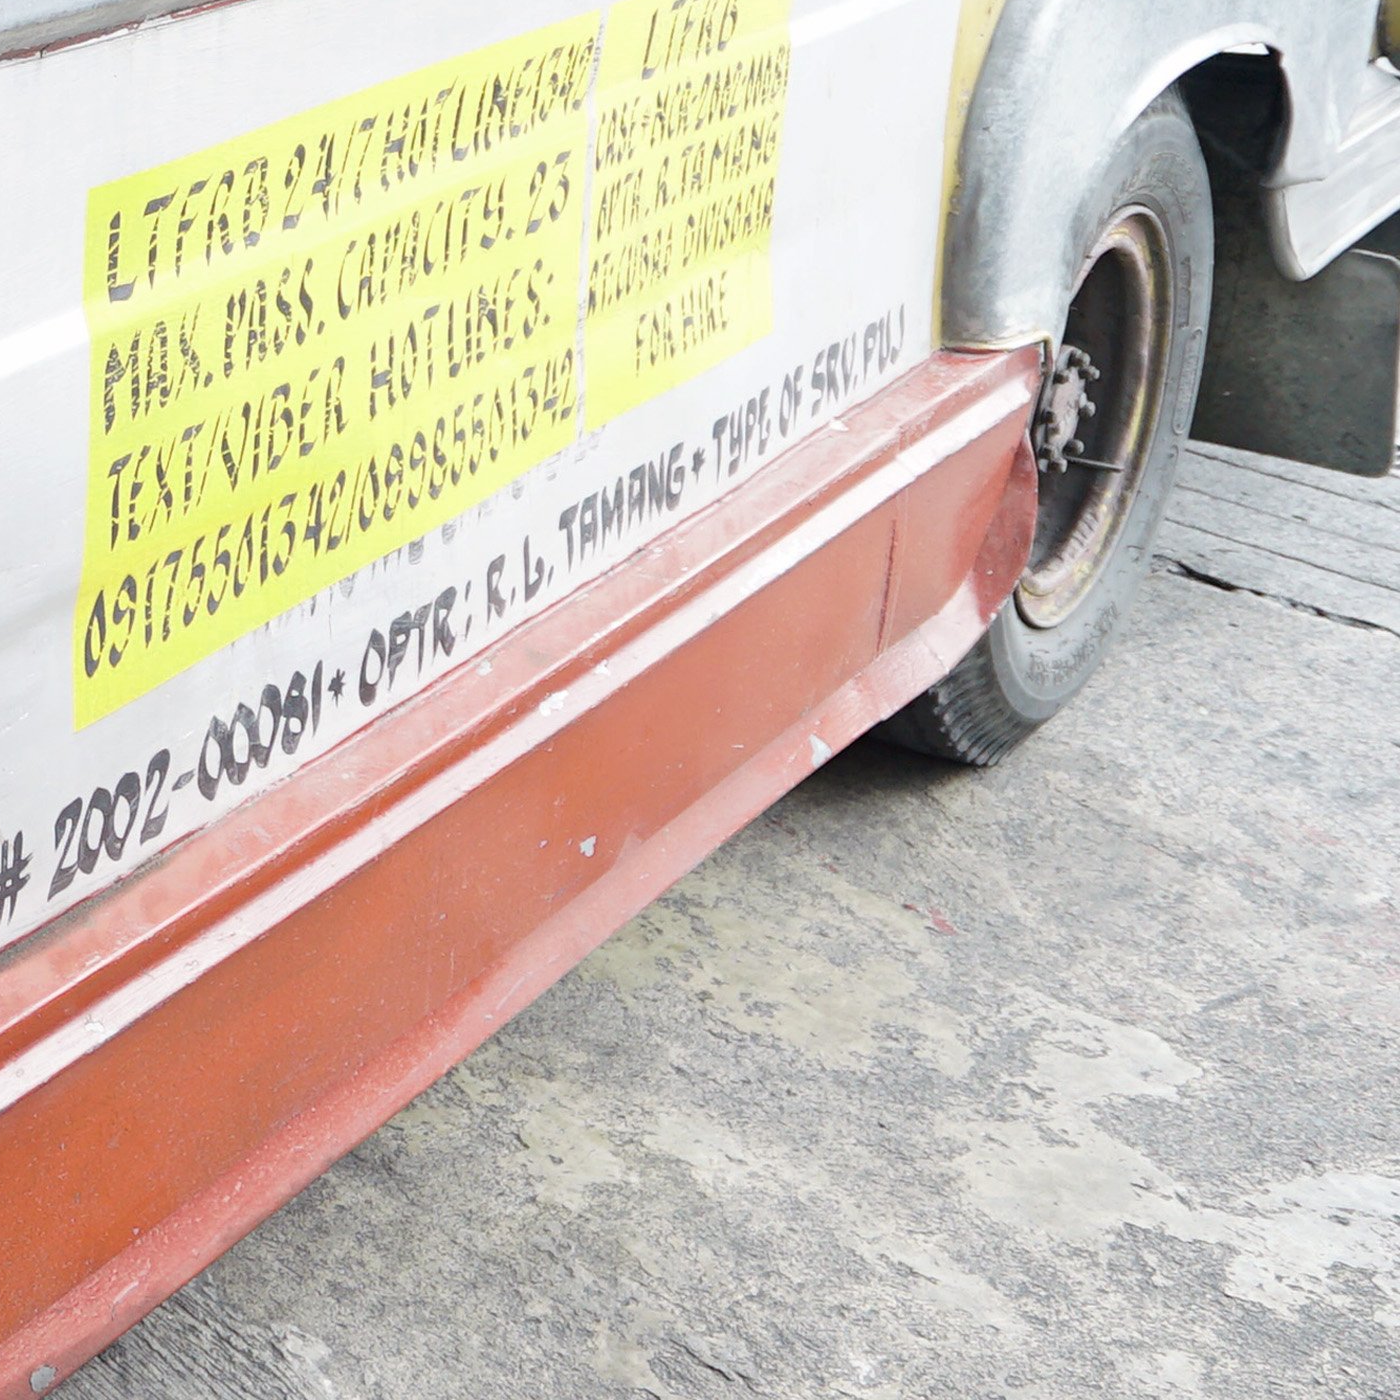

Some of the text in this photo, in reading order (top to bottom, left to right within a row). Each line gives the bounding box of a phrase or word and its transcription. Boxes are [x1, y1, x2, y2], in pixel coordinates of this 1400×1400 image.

[107, 156, 270, 304] LTFRB
[283, 112, 379, 230] 24/7
[526, 149, 573, 237] 23
[635, 302, 677, 378] FOR
[681, 270, 728, 353] HIRE
[559, 442, 686, 573] TAMANG
[712, 386, 772, 484] TYPE
[778, 364, 804, 439] OF
[863, 303, 906, 384] PUJ
